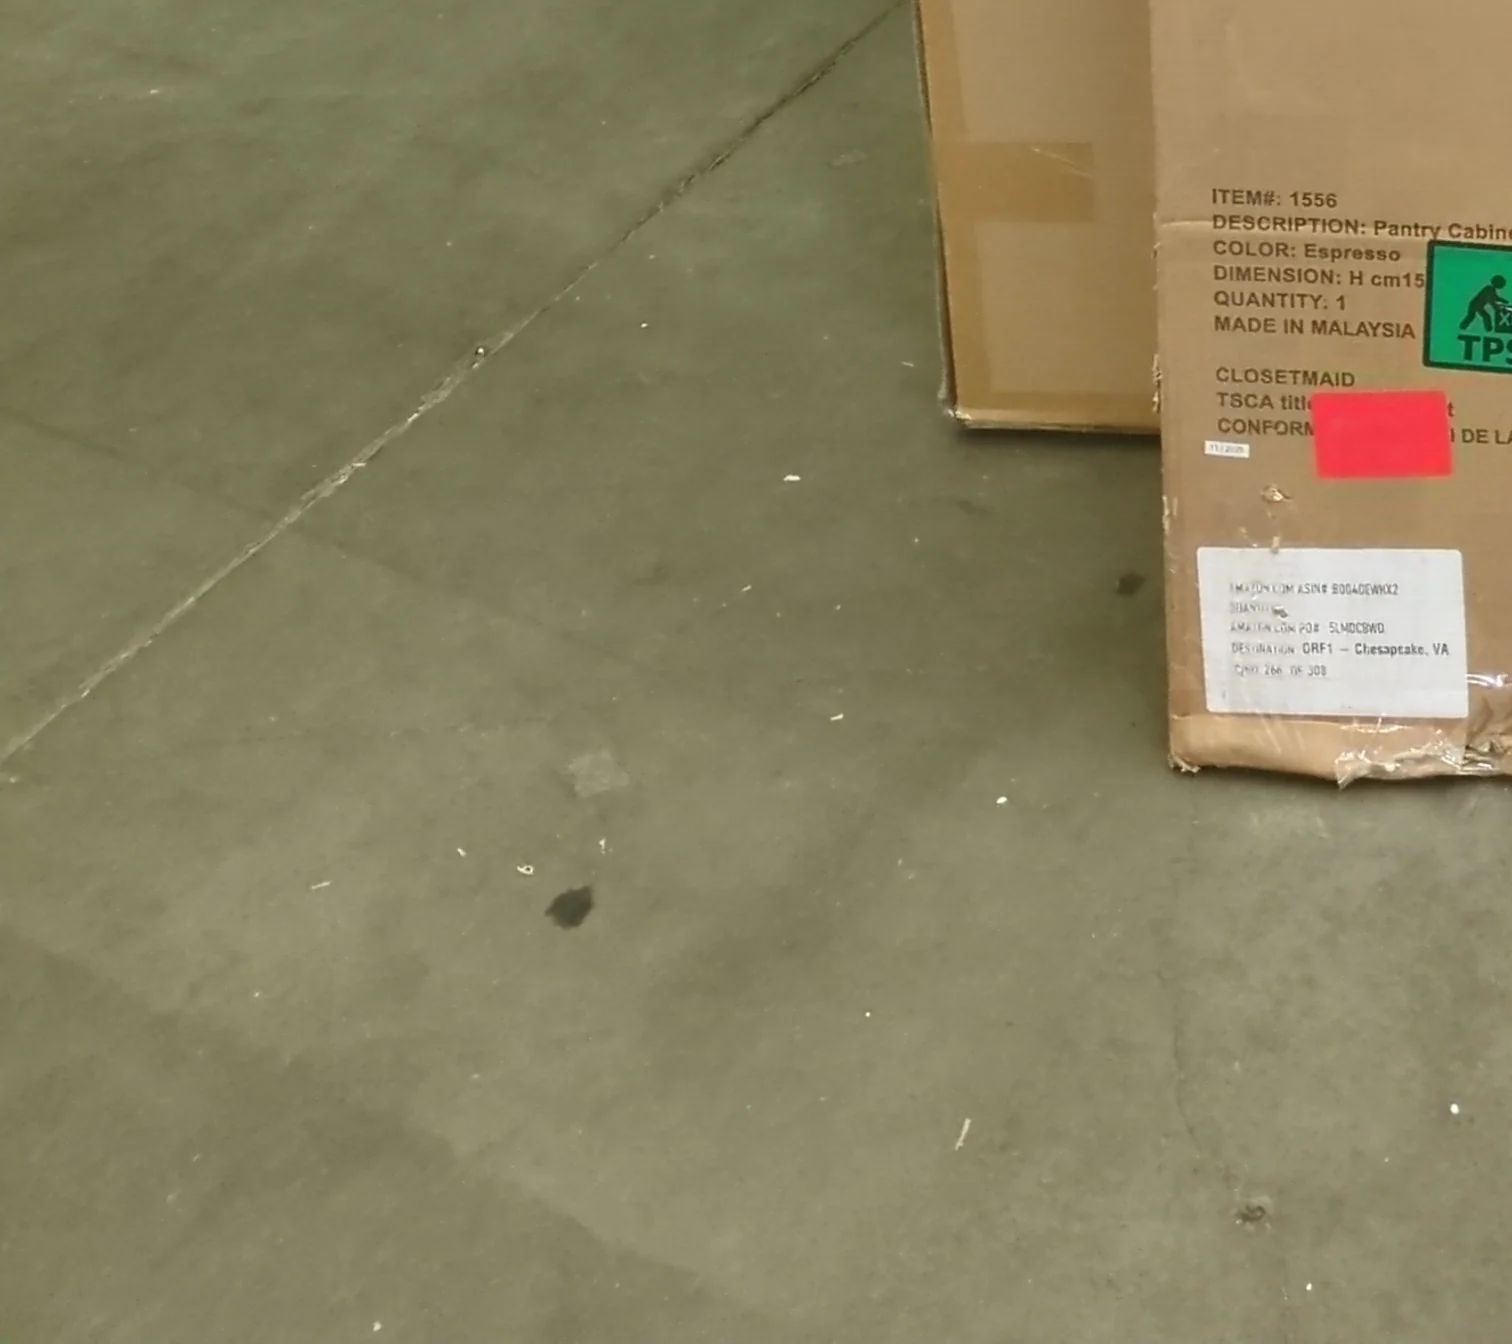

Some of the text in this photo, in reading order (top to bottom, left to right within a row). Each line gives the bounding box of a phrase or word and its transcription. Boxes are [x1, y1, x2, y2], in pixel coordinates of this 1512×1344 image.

[1212, 188, 1338, 209] ITEM#: 1556
[1212, 214, 1367, 235] DESCRIPTION:
[1373, 219, 1442, 240] Pantry
[1213, 239, 1402, 263] COLOR: Espresso
[1213, 264, 1342, 286] DIMENSION:
[1349, 270, 1364, 286] H
[1213, 289, 1346, 311] QUANTITY: 1
[1214, 314, 1416, 340] MADE IN MALAYSIA
[1215, 366, 1356, 388] CLOSETMAID
[1216, 391, 1274, 410] TSCA
[1461, 428, 1489, 444] DE
[1302, 643, 1333, 655] ORF1
[1432, 643, 1450, 656] VA
